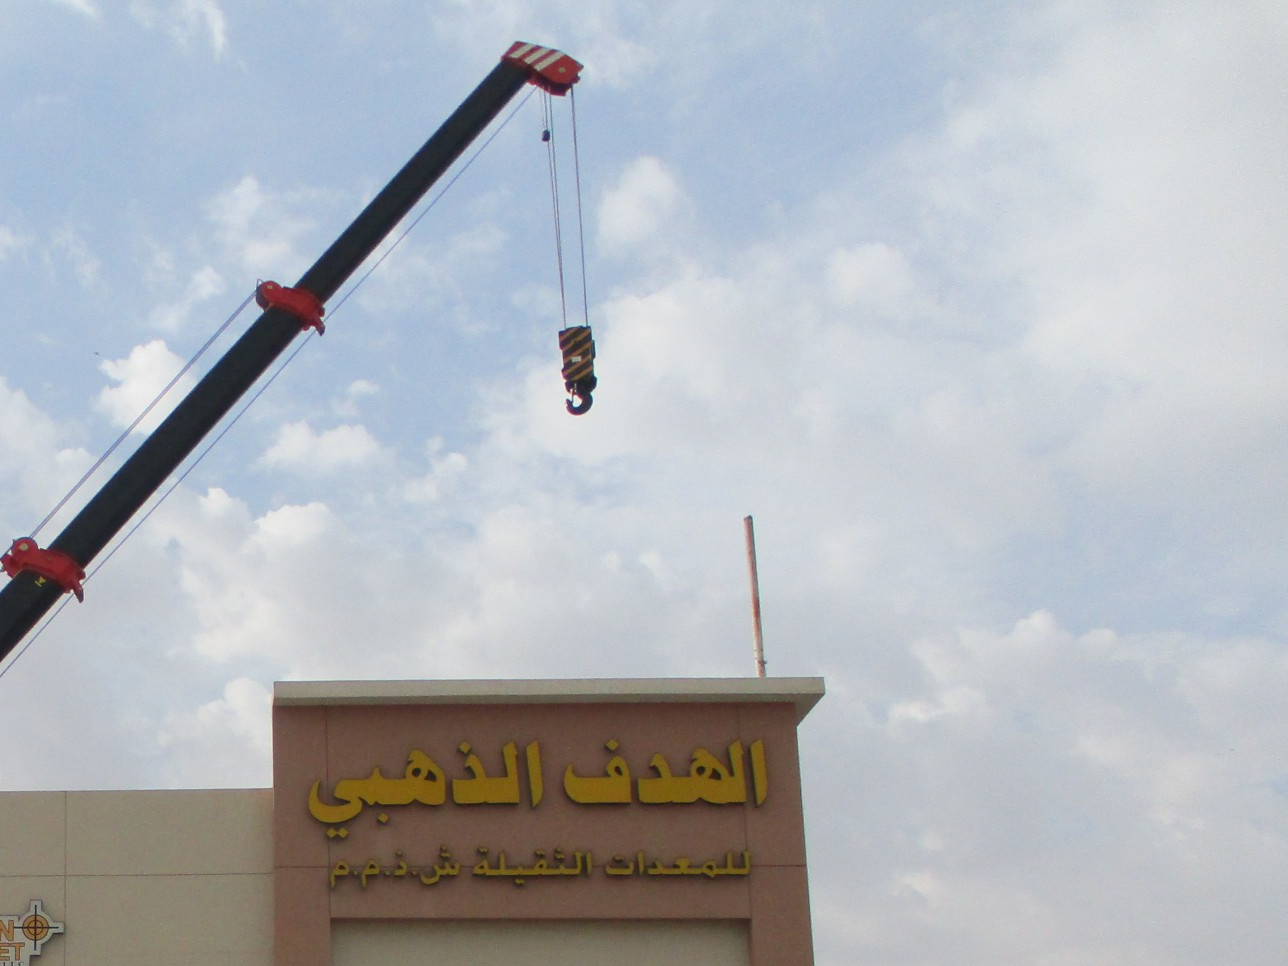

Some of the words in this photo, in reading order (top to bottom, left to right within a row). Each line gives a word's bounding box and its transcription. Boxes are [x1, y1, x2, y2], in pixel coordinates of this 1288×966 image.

[309, 738, 541, 839] الذهبي
[563, 738, 768, 808] الهدف
[472, 846, 593, 886] الثقيلة
[605, 850, 751, 879] للمعدات
